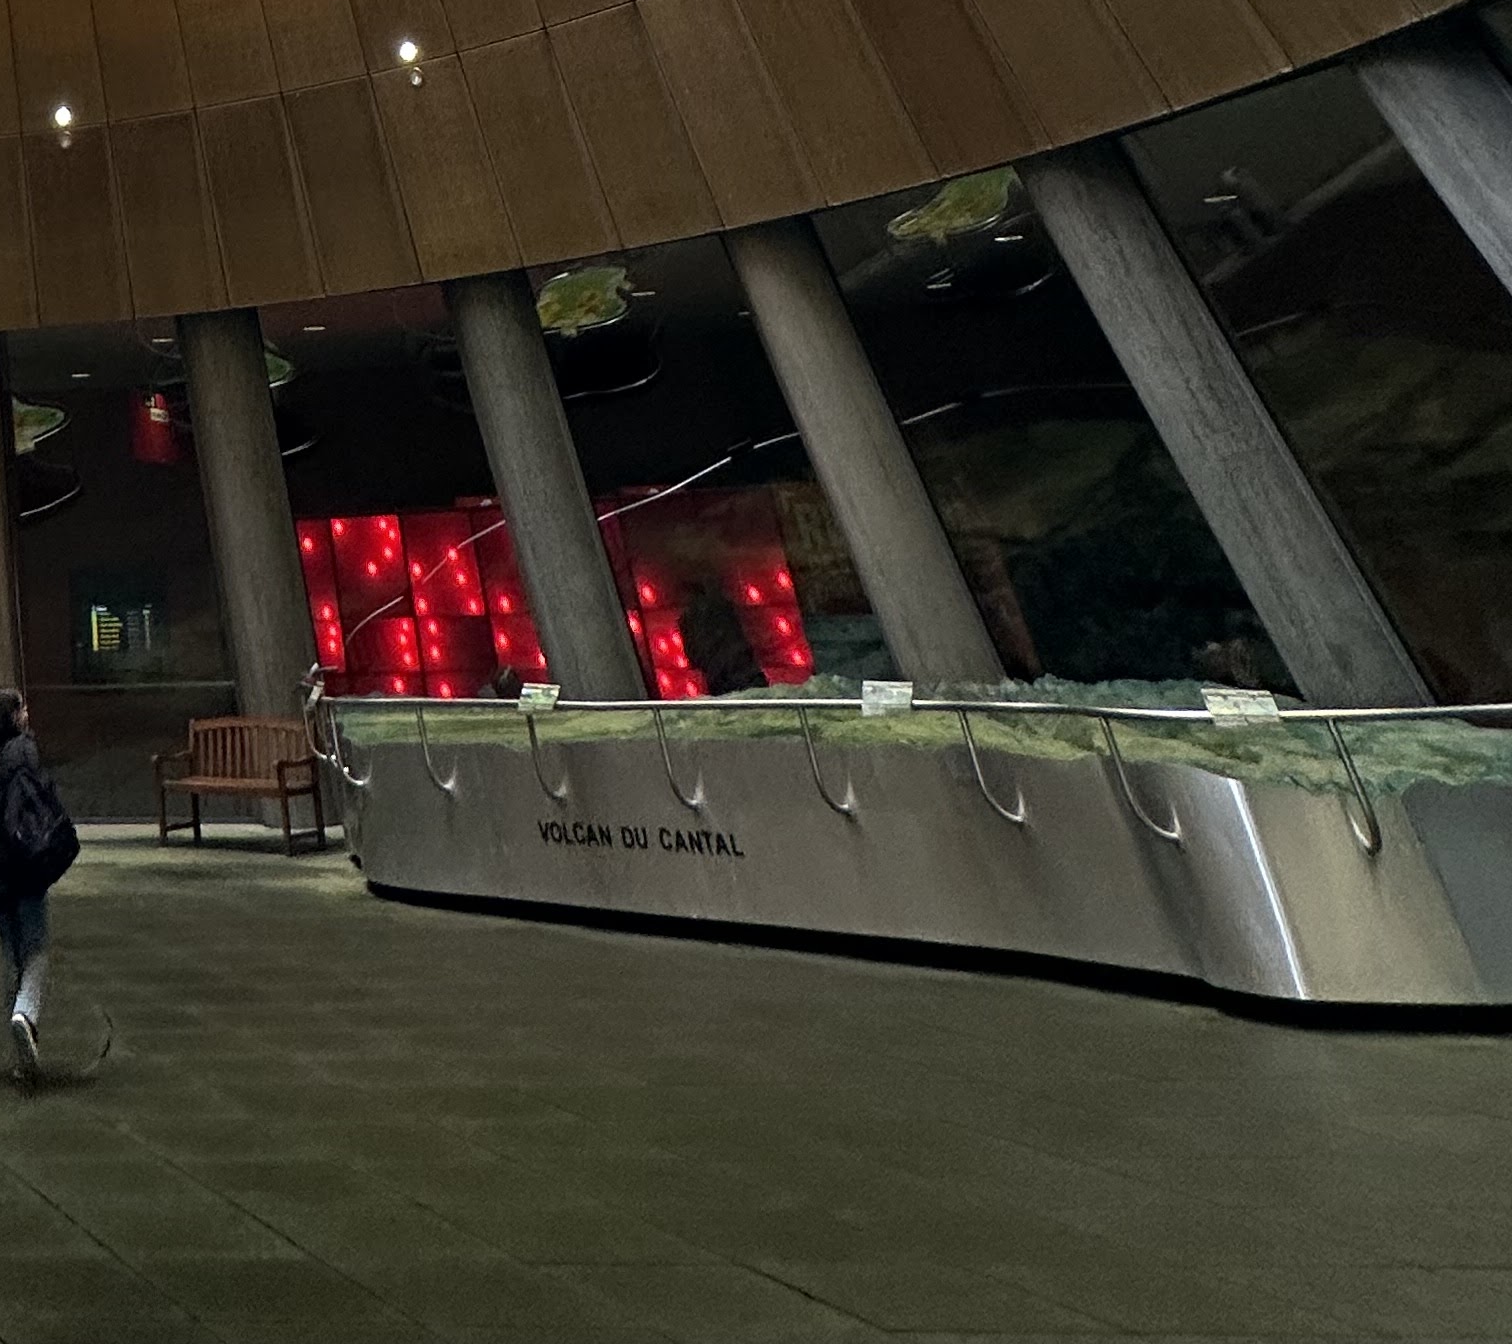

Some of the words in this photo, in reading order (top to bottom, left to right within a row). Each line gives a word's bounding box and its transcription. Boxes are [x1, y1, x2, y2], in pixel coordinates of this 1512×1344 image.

[538, 821, 612, 847] VOLCAN
[621, 826, 648, 849] DU
[658, 827, 746, 858] CANTAL
